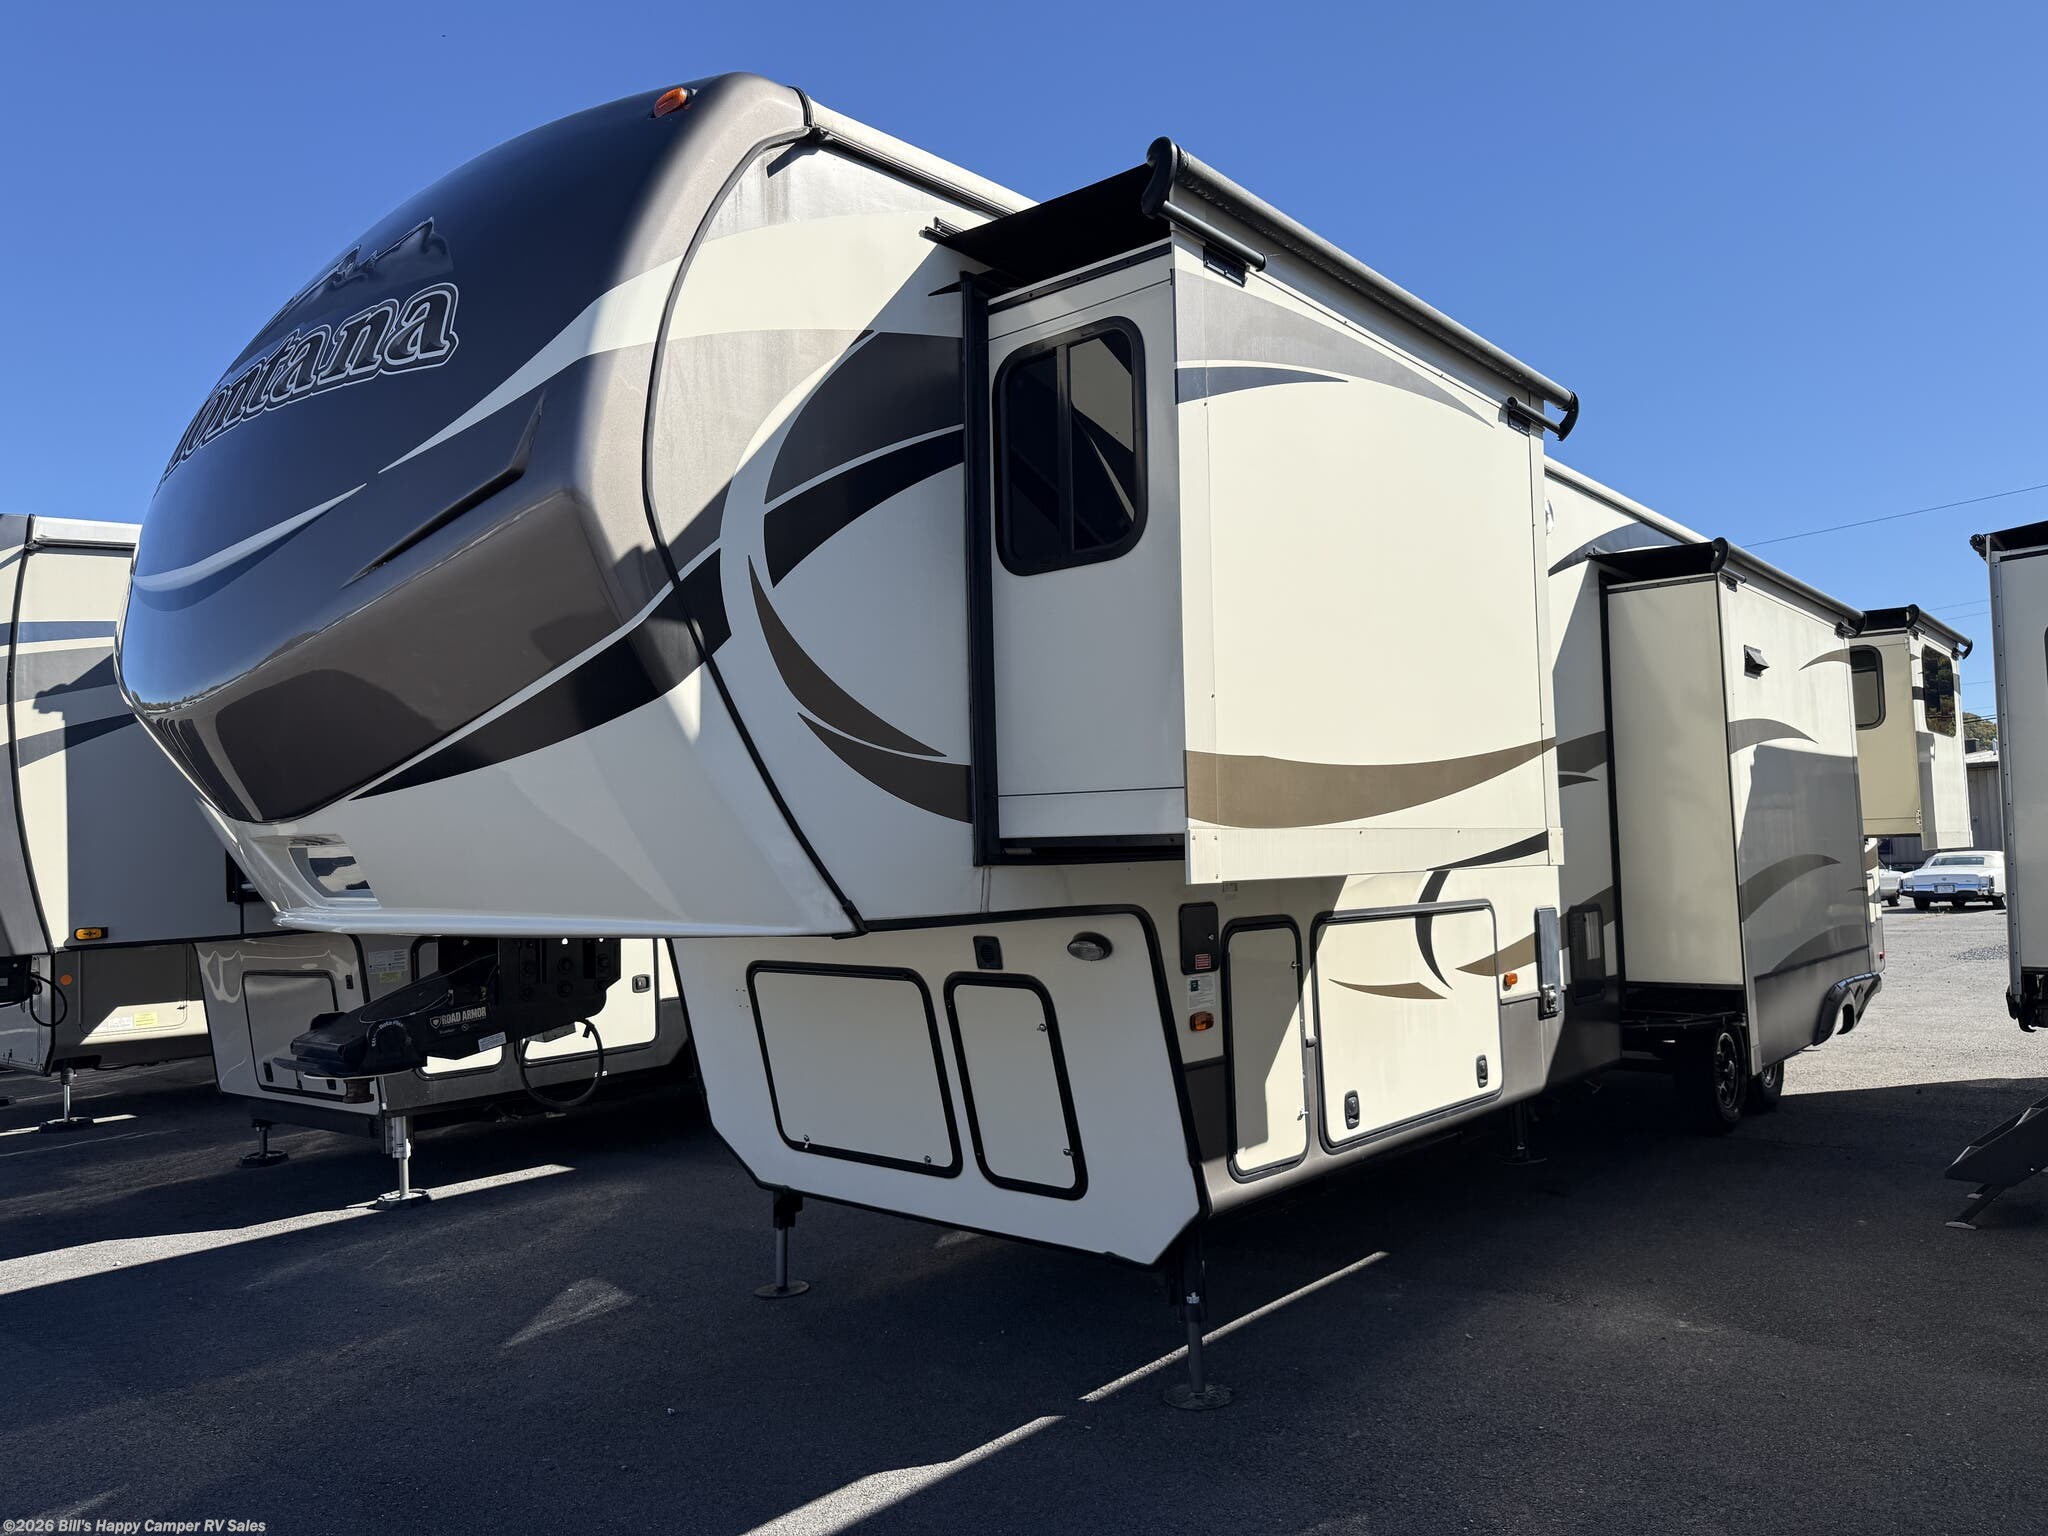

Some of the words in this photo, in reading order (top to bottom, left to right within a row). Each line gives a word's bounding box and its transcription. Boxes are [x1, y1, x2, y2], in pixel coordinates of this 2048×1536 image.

[158, 282, 459, 486] ontana
[441, 1011, 461, 1024] ROAD
[462, 1006, 487, 1021] ARMOR
